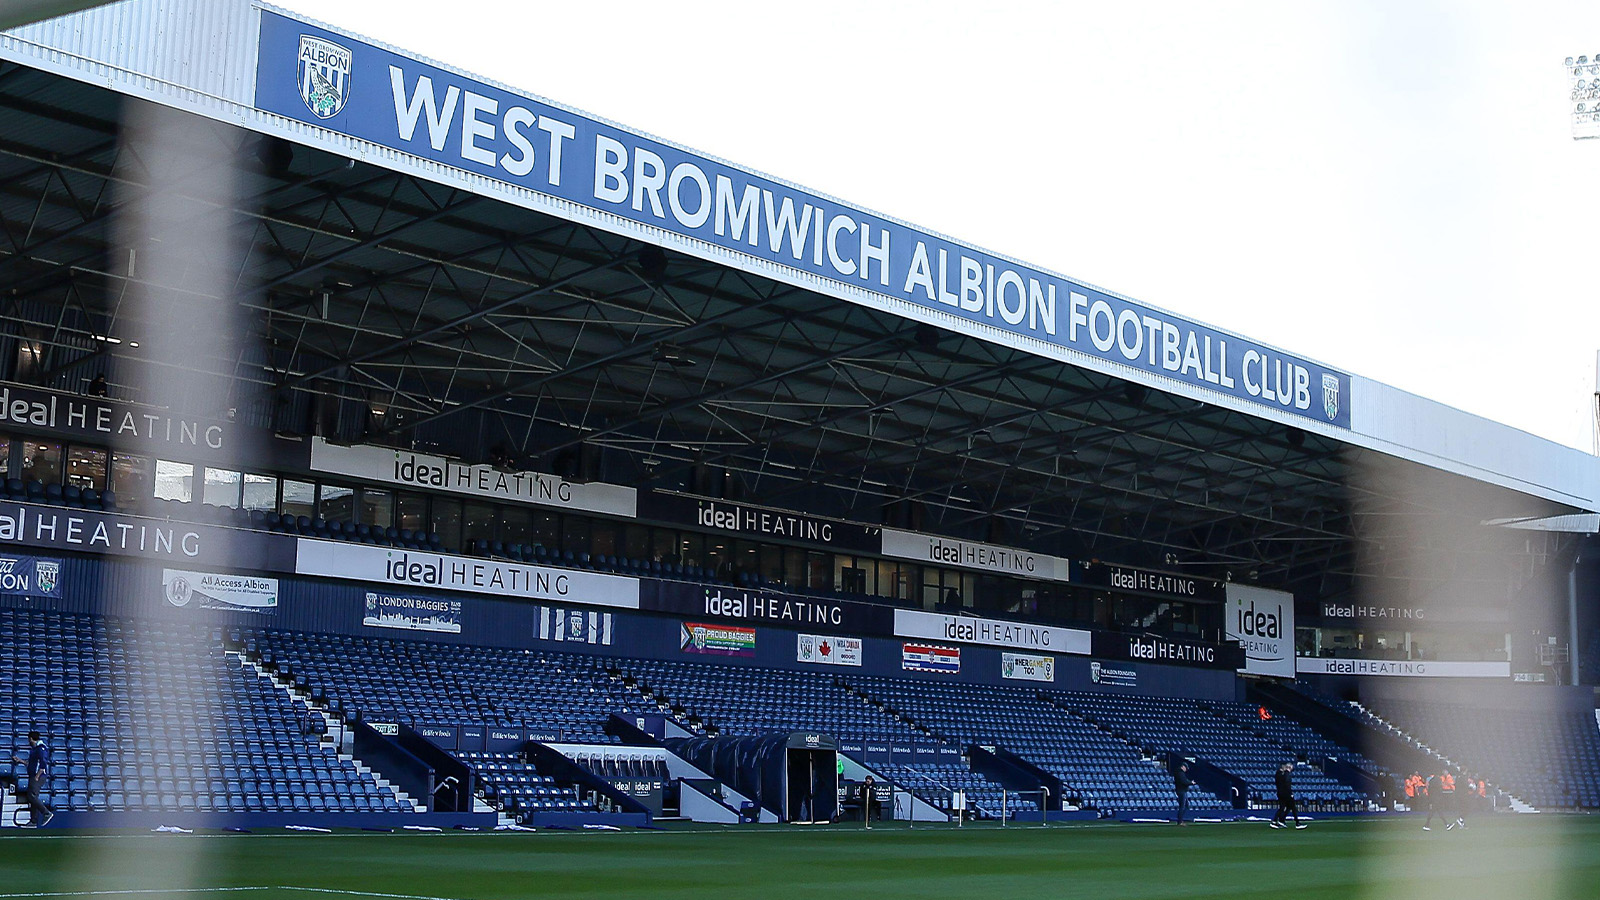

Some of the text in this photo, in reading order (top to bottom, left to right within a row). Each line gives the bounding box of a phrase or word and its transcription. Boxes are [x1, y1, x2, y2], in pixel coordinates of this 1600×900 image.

[302, 46, 348, 70] ALBION
[388, 64, 1311, 411] WEST BROMWICH ALBION FOOTBALL CLUB
[0, 388, 223, 449] deal HEATING
[394, 452, 572, 502] ideal HEATING
[698, 501, 832, 542] ideal HEATING
[36, 513, 200, 557] HEATING
[929, 538, 1035, 572] ideal HEATING
[214, 578, 242, 588] Access
[244, 580, 270, 590] Albion
[386, 552, 570, 595] ideal HEATING
[1111, 568, 1195, 595] ideal HEATING
[380, 596, 414, 609] LONDON
[416, 600, 449, 612] BAGGIES
[705, 589, 842, 625] ideal HEATING
[1325, 604, 1424, 620] ideal HEATING
[944, 617, 1050, 647] ideal HEATING
[1238, 599, 1283, 639] ideal
[706, 630, 754, 642] PROUD BAGGIES
[1130, 638, 1214, 663] ideal HEATING
[1024, 667, 1034, 675] TOO
[1326, 660, 1425, 674] ideal HEATING
[805, 734, 819, 743] ideal
[614, 781, 630, 791] ideal
[635, 781, 651, 791] ideal
